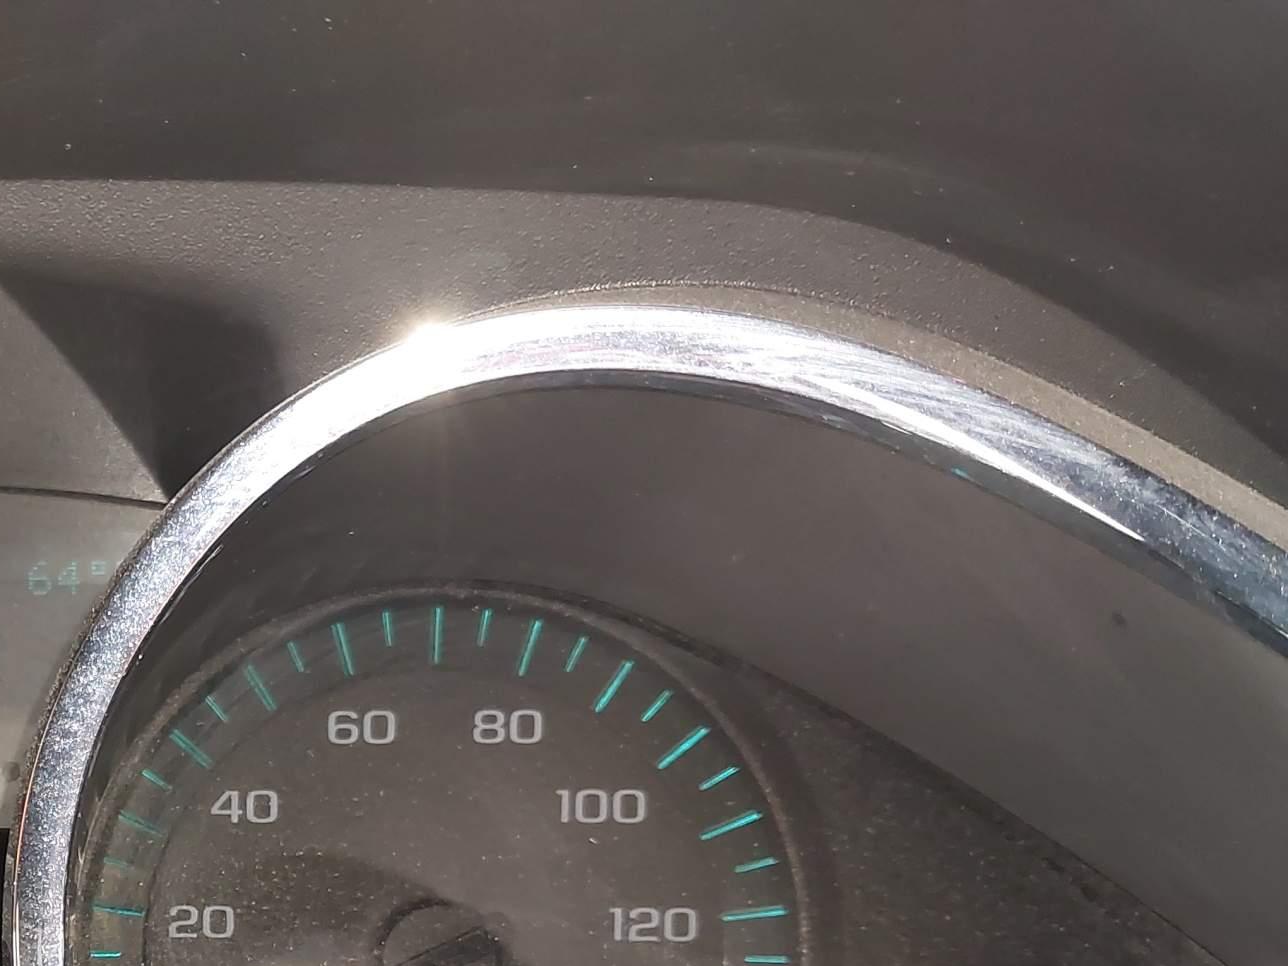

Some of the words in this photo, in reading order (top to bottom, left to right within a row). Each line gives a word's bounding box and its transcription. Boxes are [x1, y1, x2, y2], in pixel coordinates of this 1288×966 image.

[326, 709, 397, 745] 60
[472, 709, 544, 745] 80
[210, 789, 279, 824] 40
[556, 789, 647, 824] 100
[168, 904, 235, 939] 20
[611, 906, 698, 943] 120
